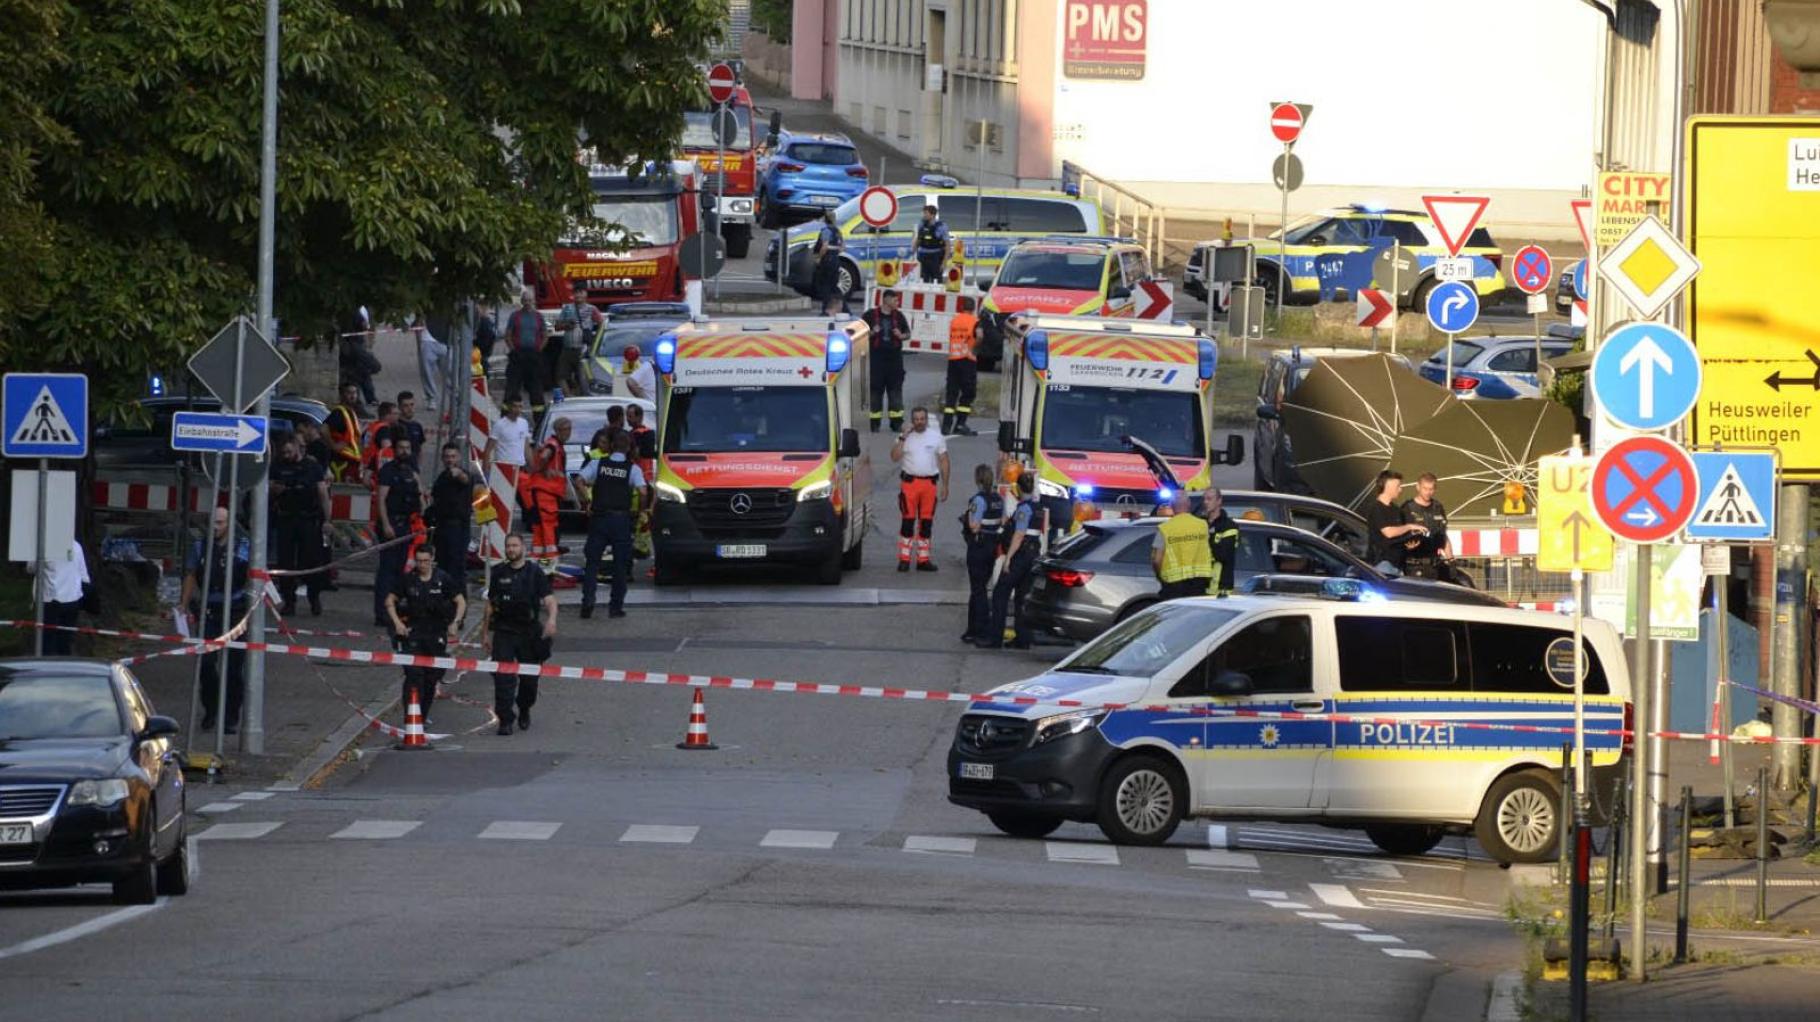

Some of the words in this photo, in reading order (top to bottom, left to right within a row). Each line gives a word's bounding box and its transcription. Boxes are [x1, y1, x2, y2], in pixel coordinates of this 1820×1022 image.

[1069, 3, 1143, 41] PMS
[1604, 175, 1670, 196] CITY
[1603, 199, 1670, 215] MART
[563, 261, 658, 277] FEUERWEHR
[1442, 264, 1455, 276] 25
[1457, 265, 1467, 276] m
[586, 278, 633, 288] IVECO
[685, 368, 733, 377] Deutsches
[1070, 363, 1123, 372] FEUERWEHR
[1709, 401, 1812, 418] Heusweiler
[1709, 424, 1801, 446] Püttlingen
[600, 465, 628, 478] POLIZEI
[686, 462, 798, 475] RETTUNGSDIENST
[1360, 723, 1456, 745] POLIZEI
